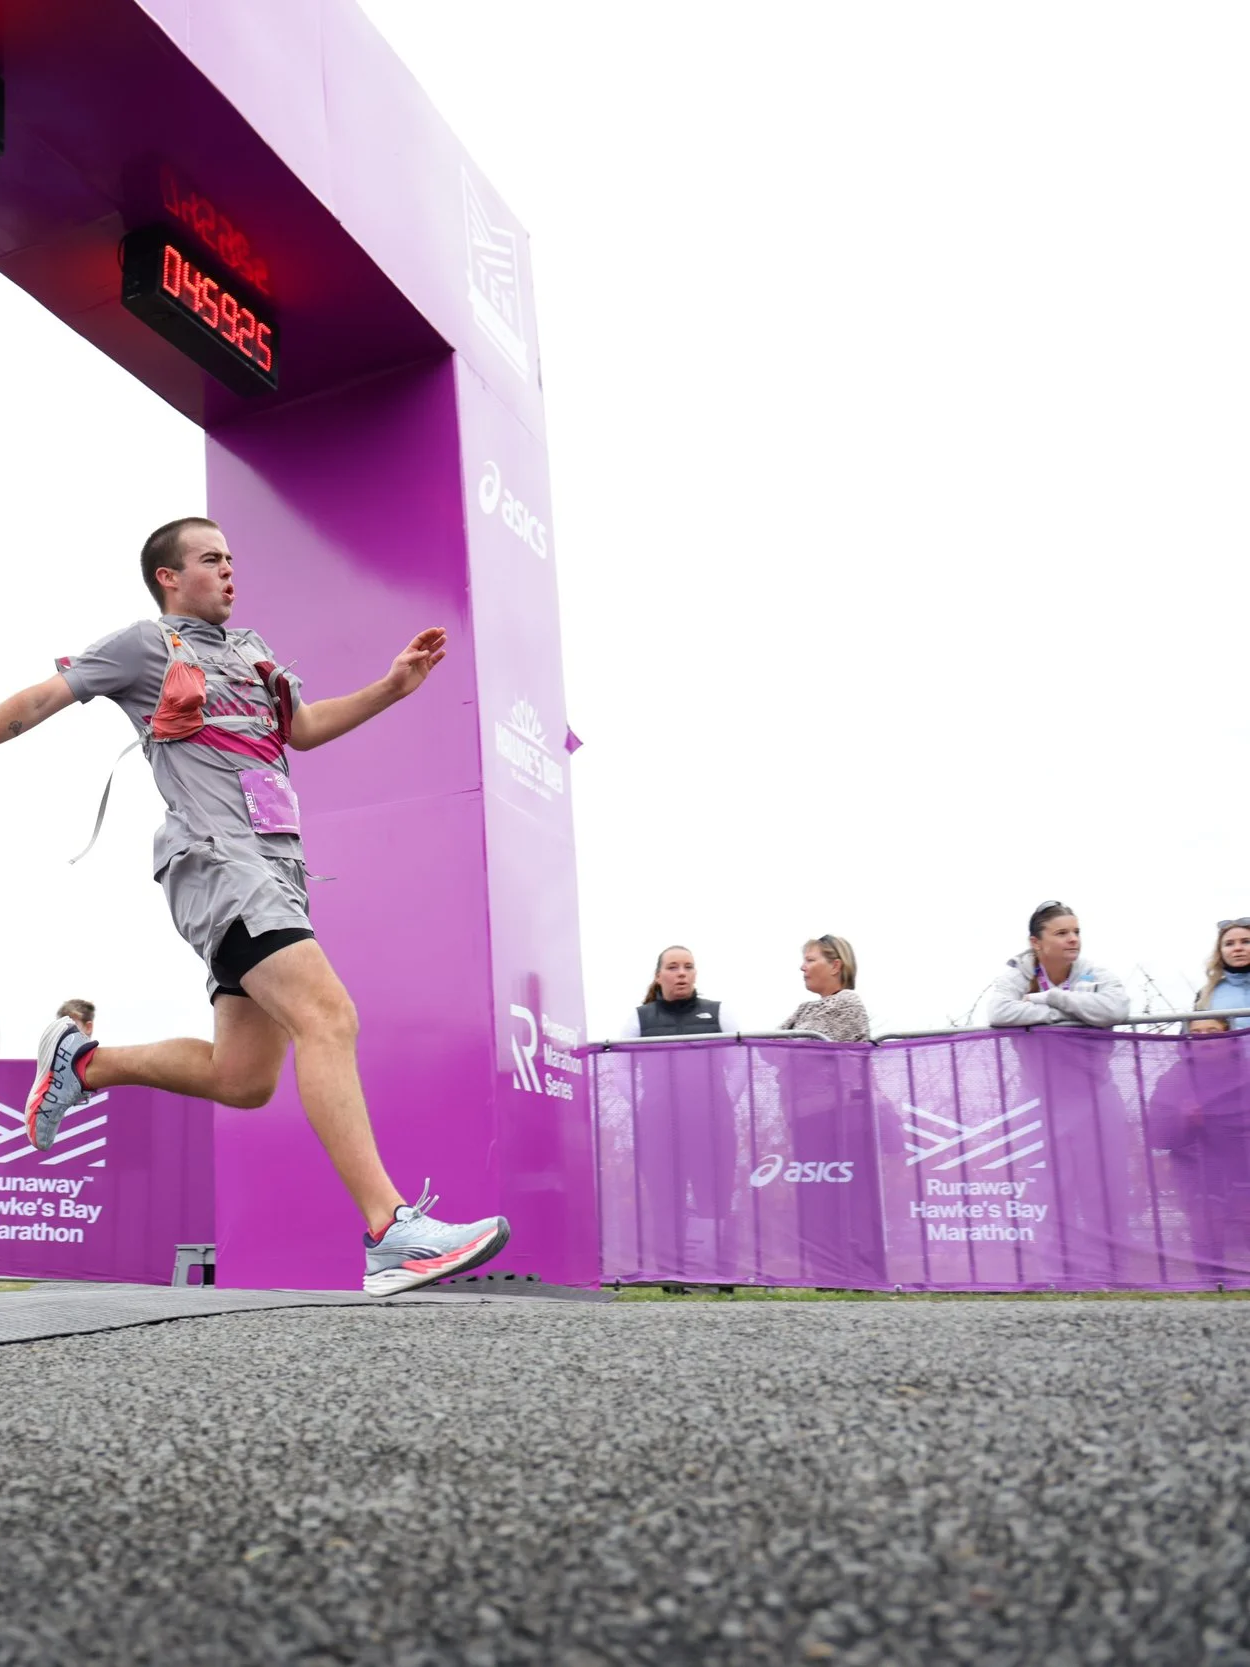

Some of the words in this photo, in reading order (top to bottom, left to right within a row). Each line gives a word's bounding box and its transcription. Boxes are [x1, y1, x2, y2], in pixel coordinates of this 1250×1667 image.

[163, 245, 272, 372] 04:59:25
[543, 1043, 583, 1076] Marathon
[34, 1046, 72, 1119] HYROX
[544, 1072, 574, 1101] Series
[783, 1161, 855, 1184] asics
[59, 1198, 103, 1224] Bay
[910, 1200, 1003, 1219] Hawke's
[1005, 1200, 1049, 1223] Bay
[926, 1223, 1035, 1241] Marathon
